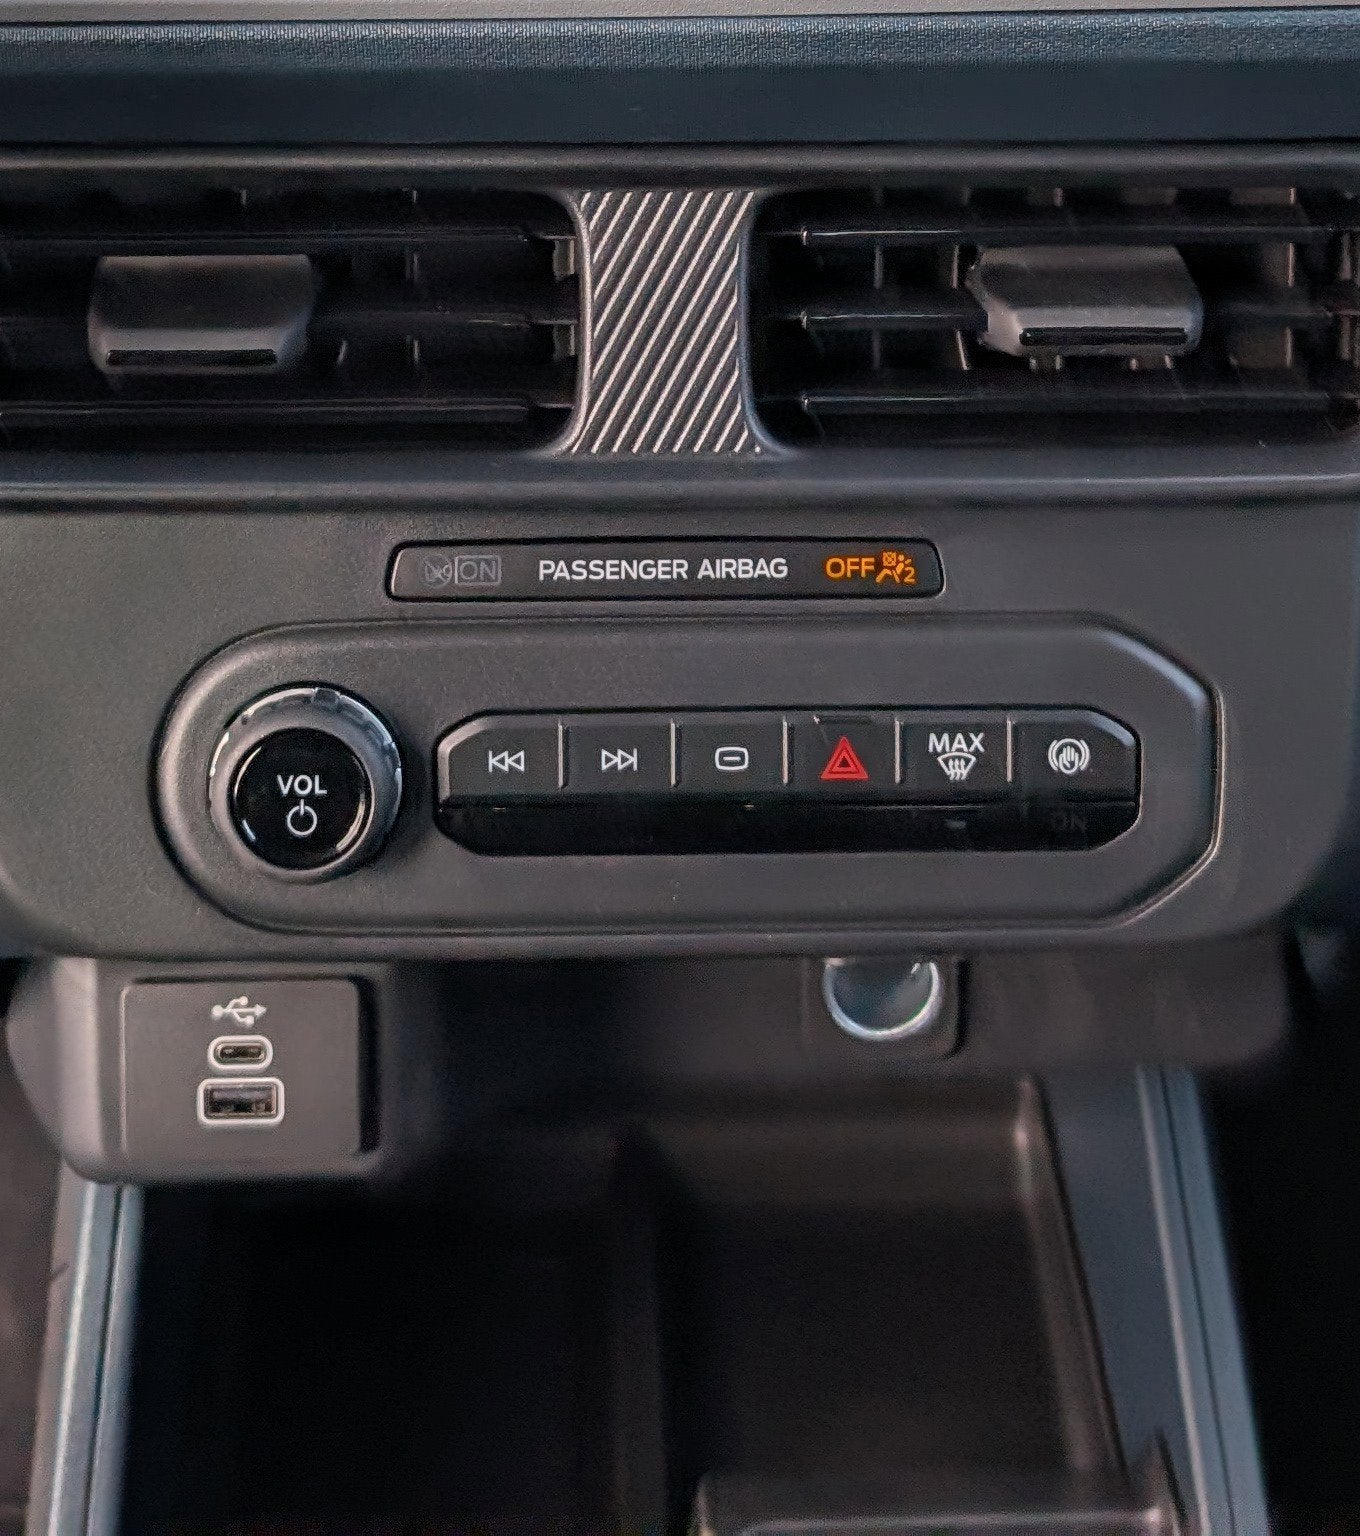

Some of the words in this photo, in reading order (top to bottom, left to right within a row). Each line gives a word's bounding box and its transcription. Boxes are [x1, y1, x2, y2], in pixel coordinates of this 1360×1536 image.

[538, 559, 690, 581] PASSENGER
[697, 556, 790, 580] AIRBAG
[824, 556, 876, 579] OFF
[927, 731, 986, 756] MAX
[277, 773, 328, 799] VOL
